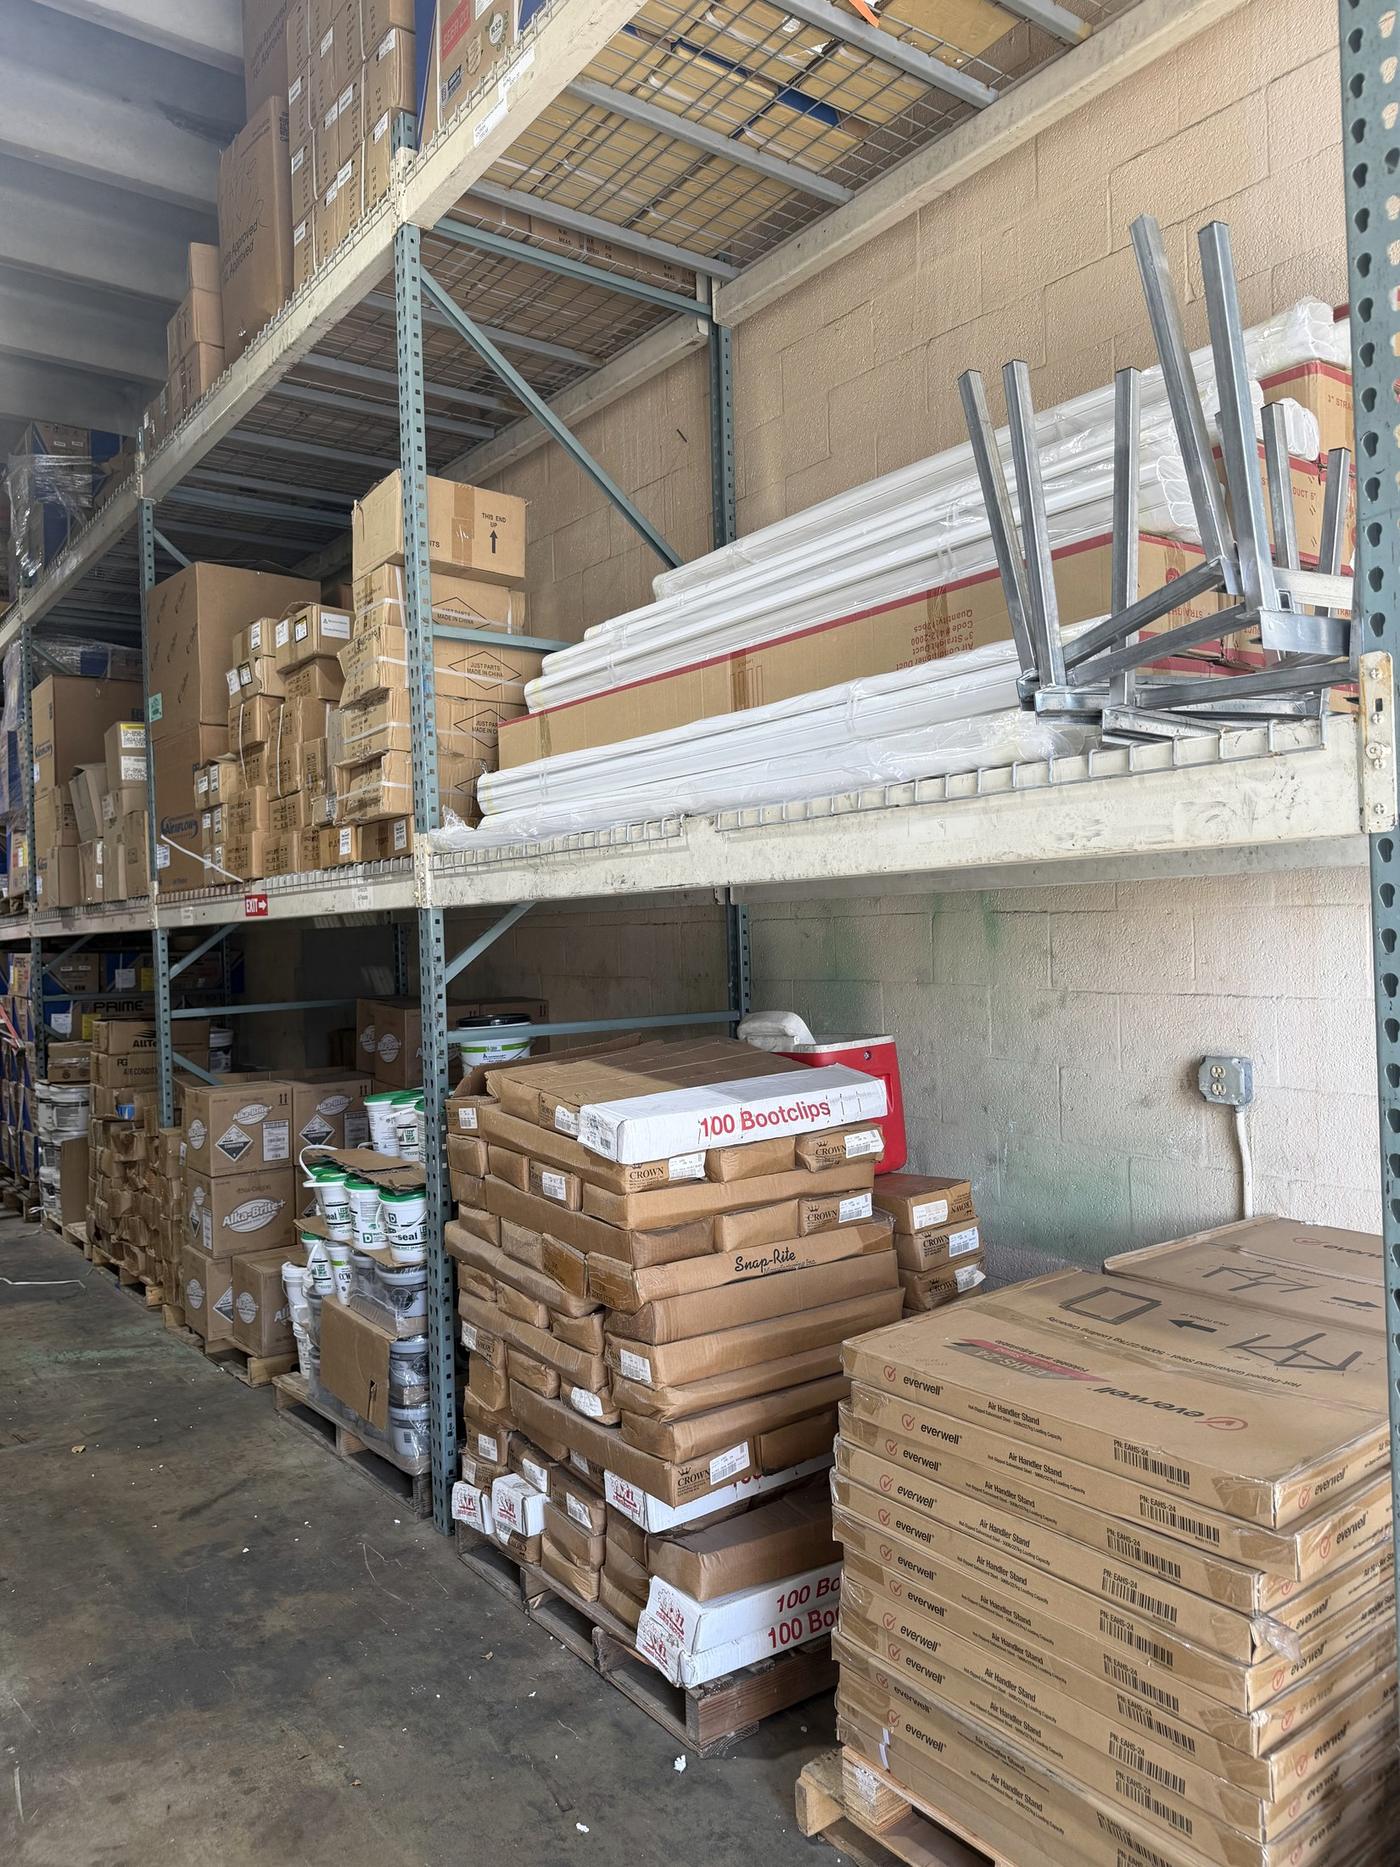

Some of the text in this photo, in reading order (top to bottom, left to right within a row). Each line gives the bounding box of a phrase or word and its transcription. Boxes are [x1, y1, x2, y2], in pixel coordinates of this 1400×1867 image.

[1292, 486, 1308, 499] DUCT
[482, 512, 507, 524] THIS END
[458, 616, 474, 625] CHINA
[952, 620, 974, 632] Code
[912, 644, 932, 654] Duct
[931, 634, 964, 650] Straight
[466, 667, 481, 675] MADE
[488, 670, 504, 678] CHINA
[470, 662, 500, 672] JUST PARTS
[896, 660, 913, 671] Duct
[246, 898, 258, 913] EXIT
[93, 1001, 144, 1014] PRIME
[700, 1100, 830, 1137] 100 Bootclips
[815, 1144, 846, 1156] CROWN
[629, 1166, 664, 1180] CROWN
[222, 1200, 286, 1227] Alka-Brite+
[807, 1208, 838, 1221] CROWN
[923, 1233, 950, 1248] CROWN
[735, 1246, 796, 1273] Snap-Rite
[929, 1279, 958, 1294] CROWN
[1046, 1316, 1080, 1331] Capacity
[1080, 1326, 1112, 1341] Loading
[974, 1350, 1048, 1376] EAHS-24
[903, 1374, 941, 1396] everwell
[987, 1400, 1040, 1426] Air Handler Stand
[1095, 1386, 1205, 1418] everwell
[920, 1424, 960, 1445] everwell
[1114, 1440, 1148, 1456] PN: EAHS-24
[903, 1450, 939, 1472] everwell
[1008, 1450, 1062, 1478] Air Handler Stand
[677, 1468, 712, 1488] CROWN
[1314, 1466, 1346, 1495] everwell
[898, 1485, 934, 1508] everwell
[984, 1479, 1036, 1508] Air Handler Stand
[1140, 1494, 1176, 1512] PN: EAHS-24
[896, 1519, 932, 1544] everwell
[979, 1516, 1030, 1548] Air Handler Stand
[1107, 1528, 1140, 1547] PN: EAHS-24
[1336, 1514, 1366, 1544] everwell
[898, 1556, 934, 1580] everwell
[976, 1553, 1028, 1586] Air Handler Stand
[1103, 1569, 1138, 1589] PN: EAHS-24
[777, 1584, 812, 1613] 100
[908, 1592, 944, 1617] everwell
[980, 1593, 1032, 1627] Air Handler Stand
[1100, 1610, 1134, 1632] PN: EAHS-24
[1296, 1599, 1328, 1629] everwell
[768, 1622, 803, 1649] 100
[900, 1625, 938, 1652] everwell
[991, 1630, 1044, 1665] Air Handler Stand
[906, 1656, 942, 1684] everwell
[1104, 1654, 1138, 1676] PN: EAHS-24
[984, 1666, 1036, 1703] Air Handler Stand
[1117, 1694, 1152, 1716] PN: EAHS-24
[990, 1700, 1042, 1738] Air Handler Stand
[906, 1724, 944, 1752] everwell
[1110, 1732, 1144, 1756] PN: EAHS-24
[990, 1772, 1043, 1812] Air Handler Stand
[1116, 1770, 1151, 1794] PN: EAHS-24
[1118, 1848, 1126, 1858] PN:
